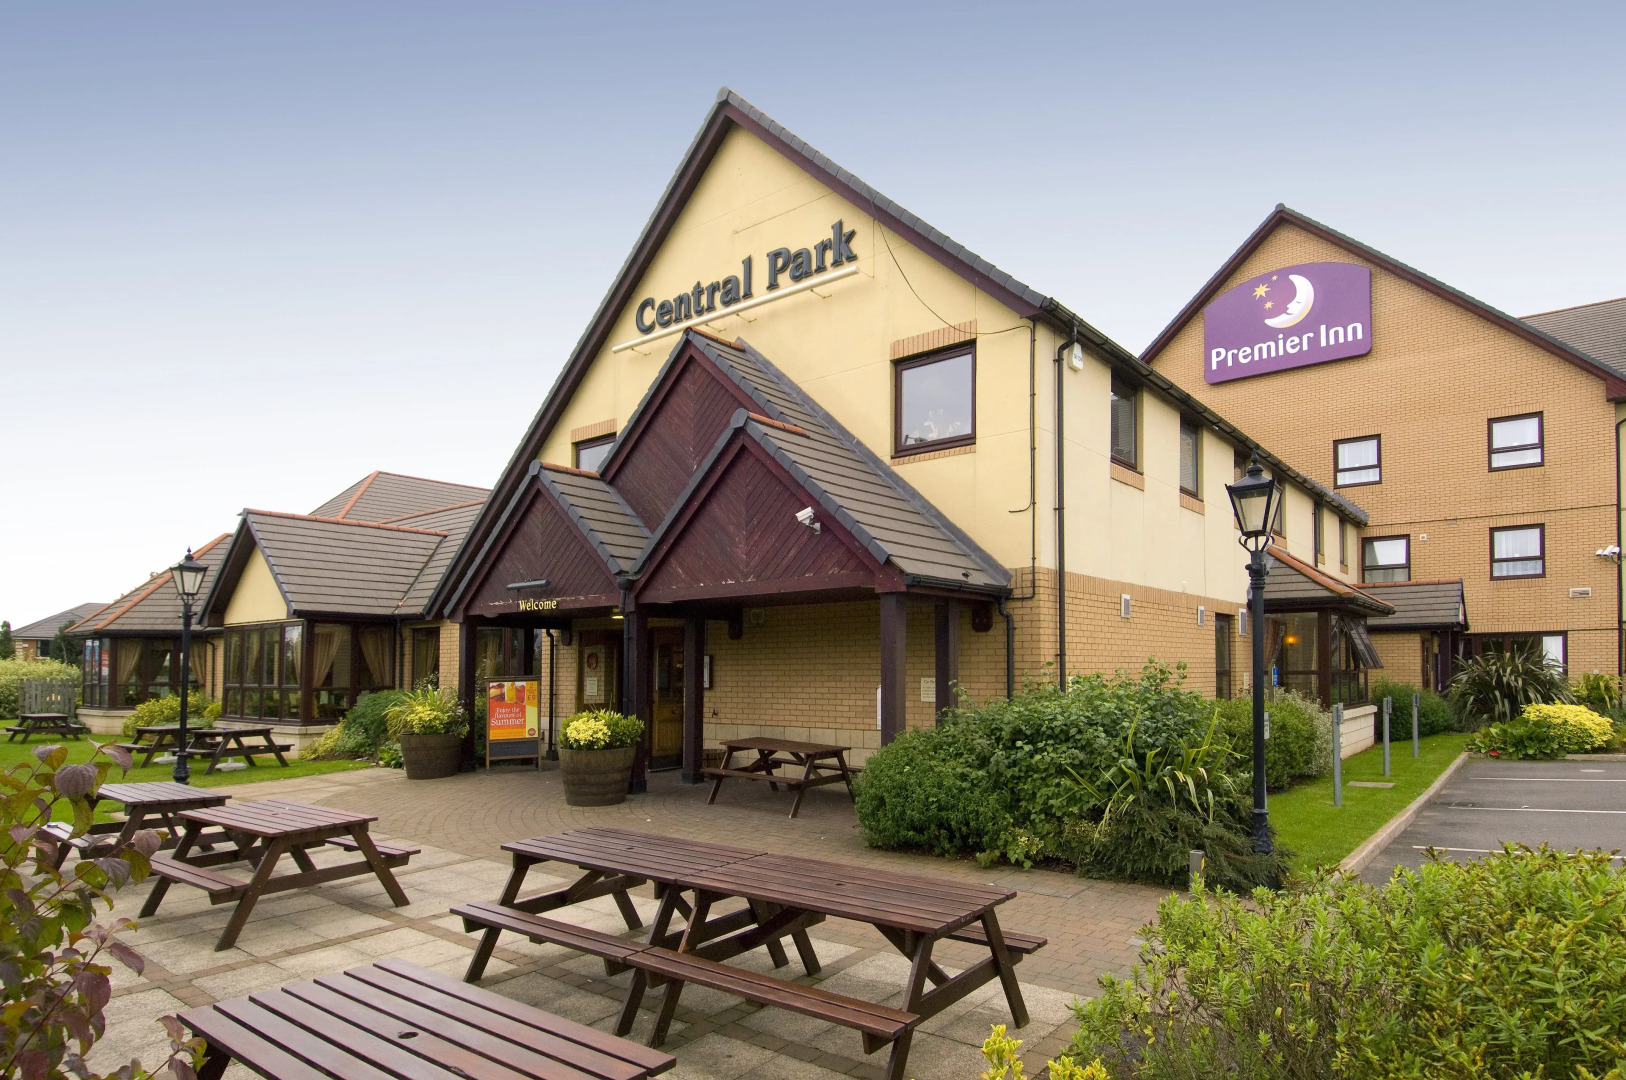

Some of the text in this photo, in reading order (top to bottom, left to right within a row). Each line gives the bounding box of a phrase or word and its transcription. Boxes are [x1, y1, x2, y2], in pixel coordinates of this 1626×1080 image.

[635, 218, 857, 335] Central Park
[1211, 322, 1363, 371] Premier Inn
[519, 598, 557, 611] Welcome
[491, 718, 524, 726] Summer
